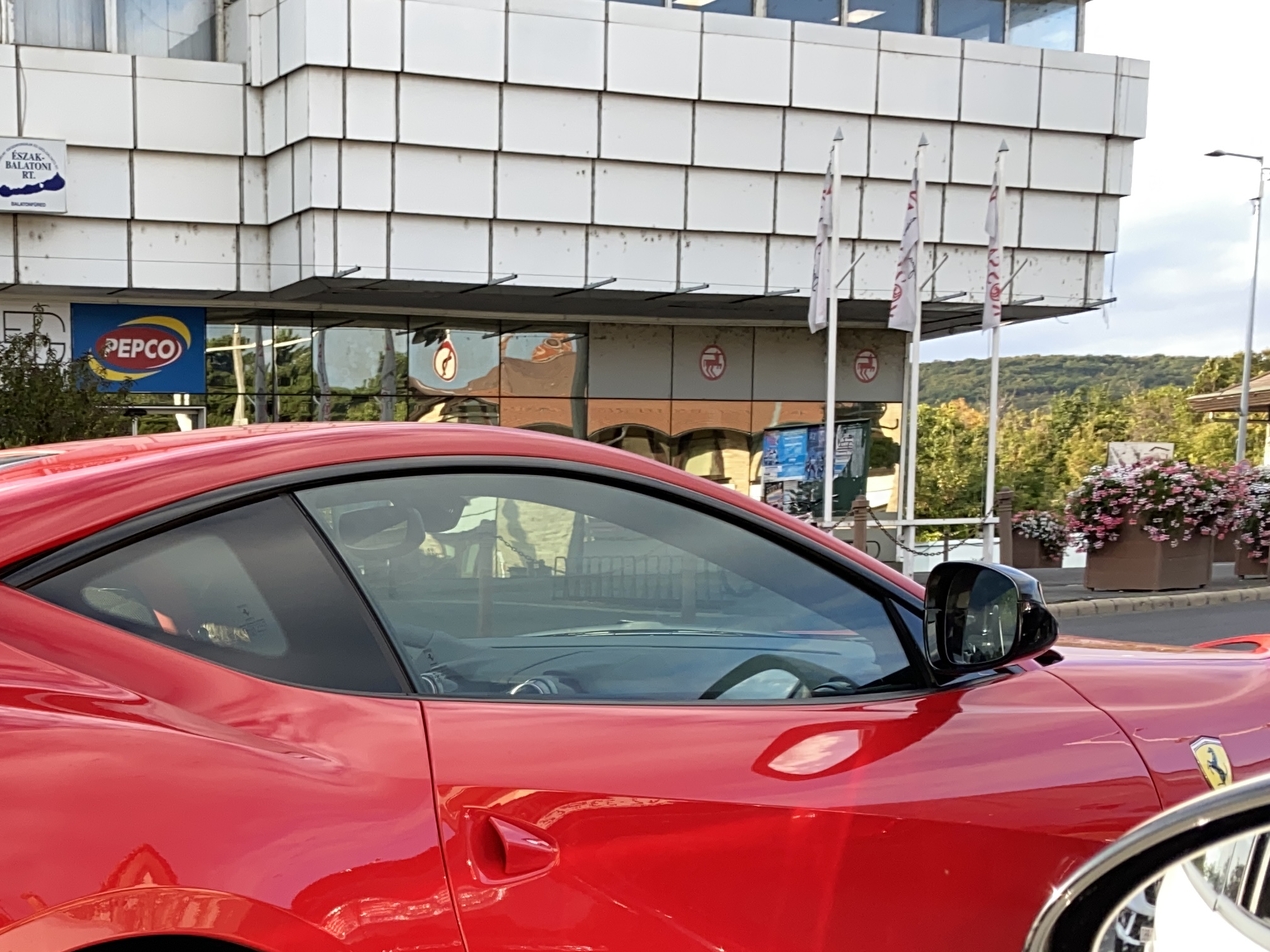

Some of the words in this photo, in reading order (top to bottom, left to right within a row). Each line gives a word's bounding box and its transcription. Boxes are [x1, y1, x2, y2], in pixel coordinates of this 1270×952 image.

[11, 150, 45, 161] ÉSZAK-
[5, 161, 52, 171] BALATONI
[22, 171, 36, 179] RT.
[104, 338, 176, 359] PEPCO
